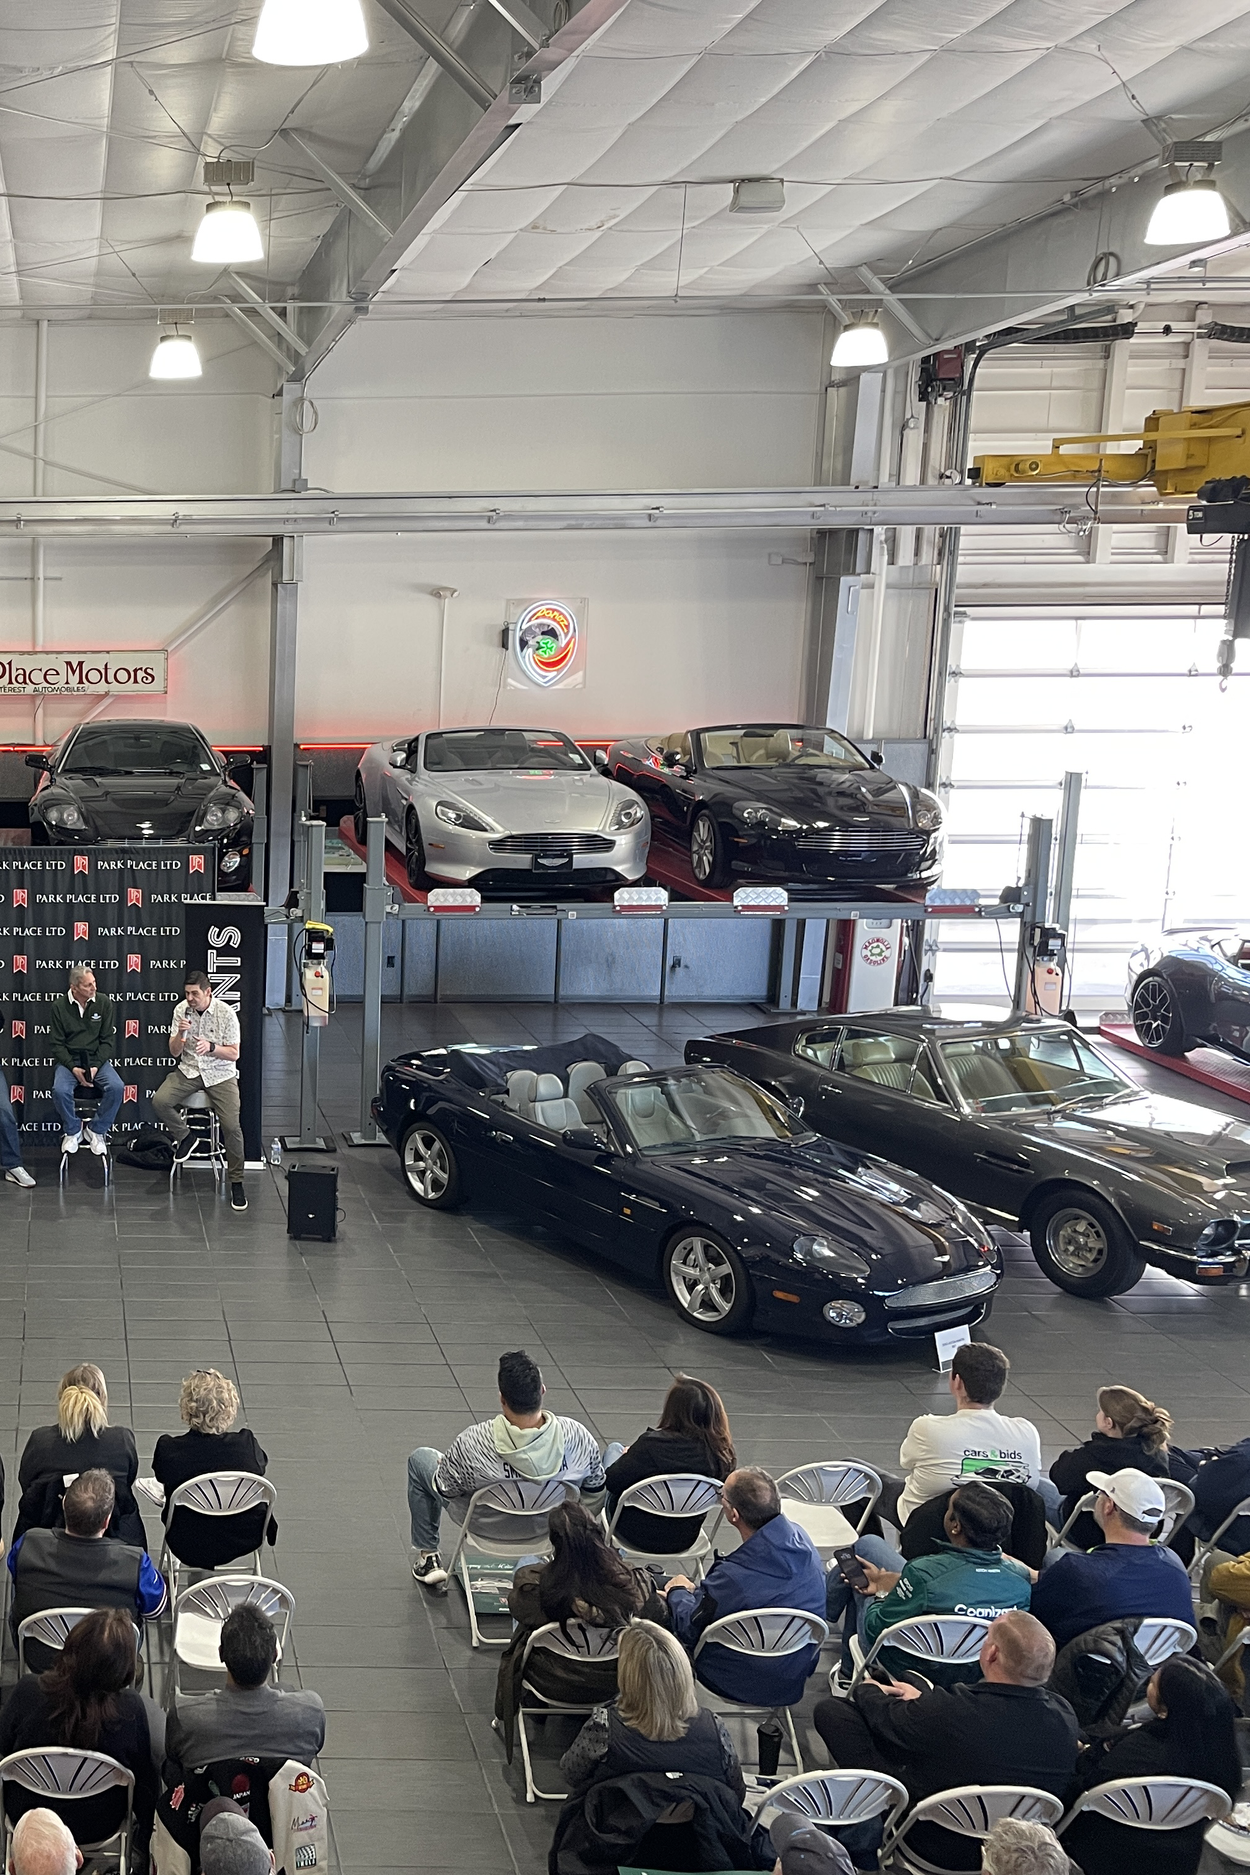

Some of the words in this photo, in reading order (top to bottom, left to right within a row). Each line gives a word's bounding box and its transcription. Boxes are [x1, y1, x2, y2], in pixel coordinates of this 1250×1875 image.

[63, 660, 156, 686] Motors
[32, 686, 86, 694] AUTOMOBILES
[12, 860, 43, 870] PLACE
[45, 860, 66, 870] LTD
[97, 860, 125, 870] PARK
[127, 859, 158, 870] PLACE
[160, 860, 181, 870] LTD
[36, 894, 64, 903] PARK
[66, 893, 97, 903] PLACE
[99, 894, 120, 903] LTD
[150, 893, 179, 903] PARK
[12, 926, 43, 936] PLACE
[45, 927, 66, 936] LTD
[97, 927, 125, 936] PARK
[127, 926, 158, 936] PLACE
[160, 927, 181, 936] LTD
[35, 960, 64, 969] PARK
[99, 960, 119, 969] LTD
[149, 960, 178, 969] PARK
[12, 992, 42, 1002] PLACE
[126, 992, 156, 1002] PLACE
[158, 992, 179, 1002] LTD
[11, 1057, 40, 1067] PLACE
[43, 1057, 55, 1067] LT
[124, 1057, 154, 1066] PLACE
[156, 1057, 177, 1067] LTD
[32, 1090, 53, 1099] PAR
[41, 1122, 62, 1131] LTD
[963, 1449, 989, 1458] cars
[990, 1449, 998, 1459] &
[999, 1449, 1023, 1460] bids
[233, 1790, 251, 1800] JAPAN
